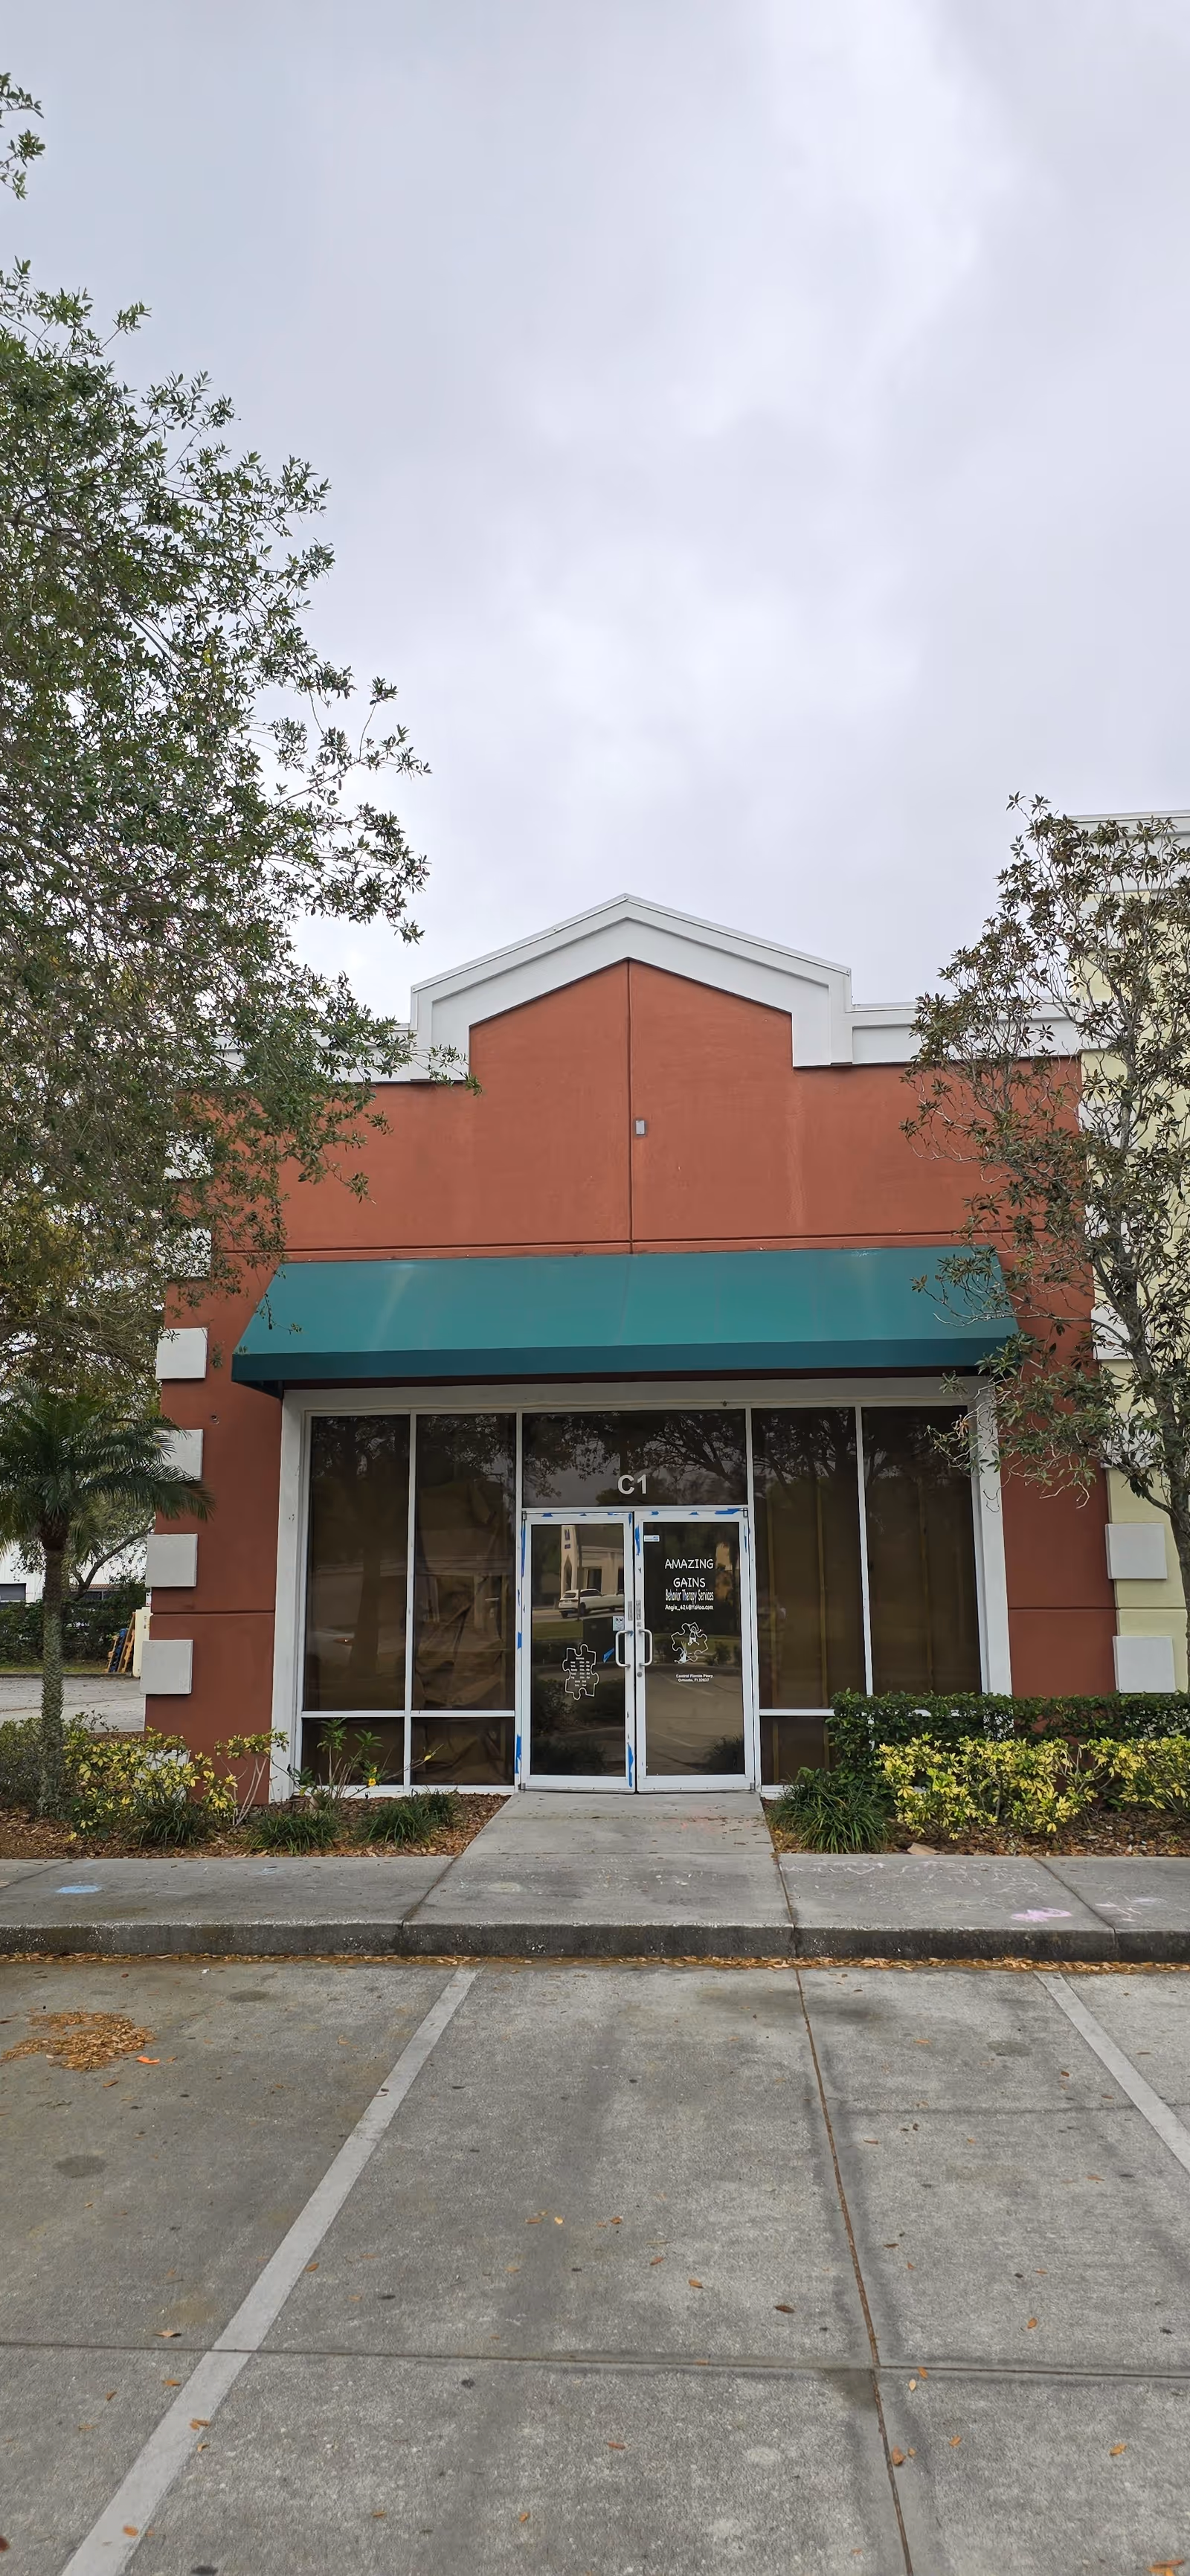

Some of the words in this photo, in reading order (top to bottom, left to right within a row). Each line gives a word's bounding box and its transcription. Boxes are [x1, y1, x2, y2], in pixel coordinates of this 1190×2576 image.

[618, 1474, 647, 1494] C1
[665, 1558, 714, 1569] AMAZING
[673, 1577, 706, 1587] GAINS
[665, 1588, 681, 1601] Behavior
[682, 1589, 698, 1605] Therapy
[698, 1589, 714, 1601] Services
